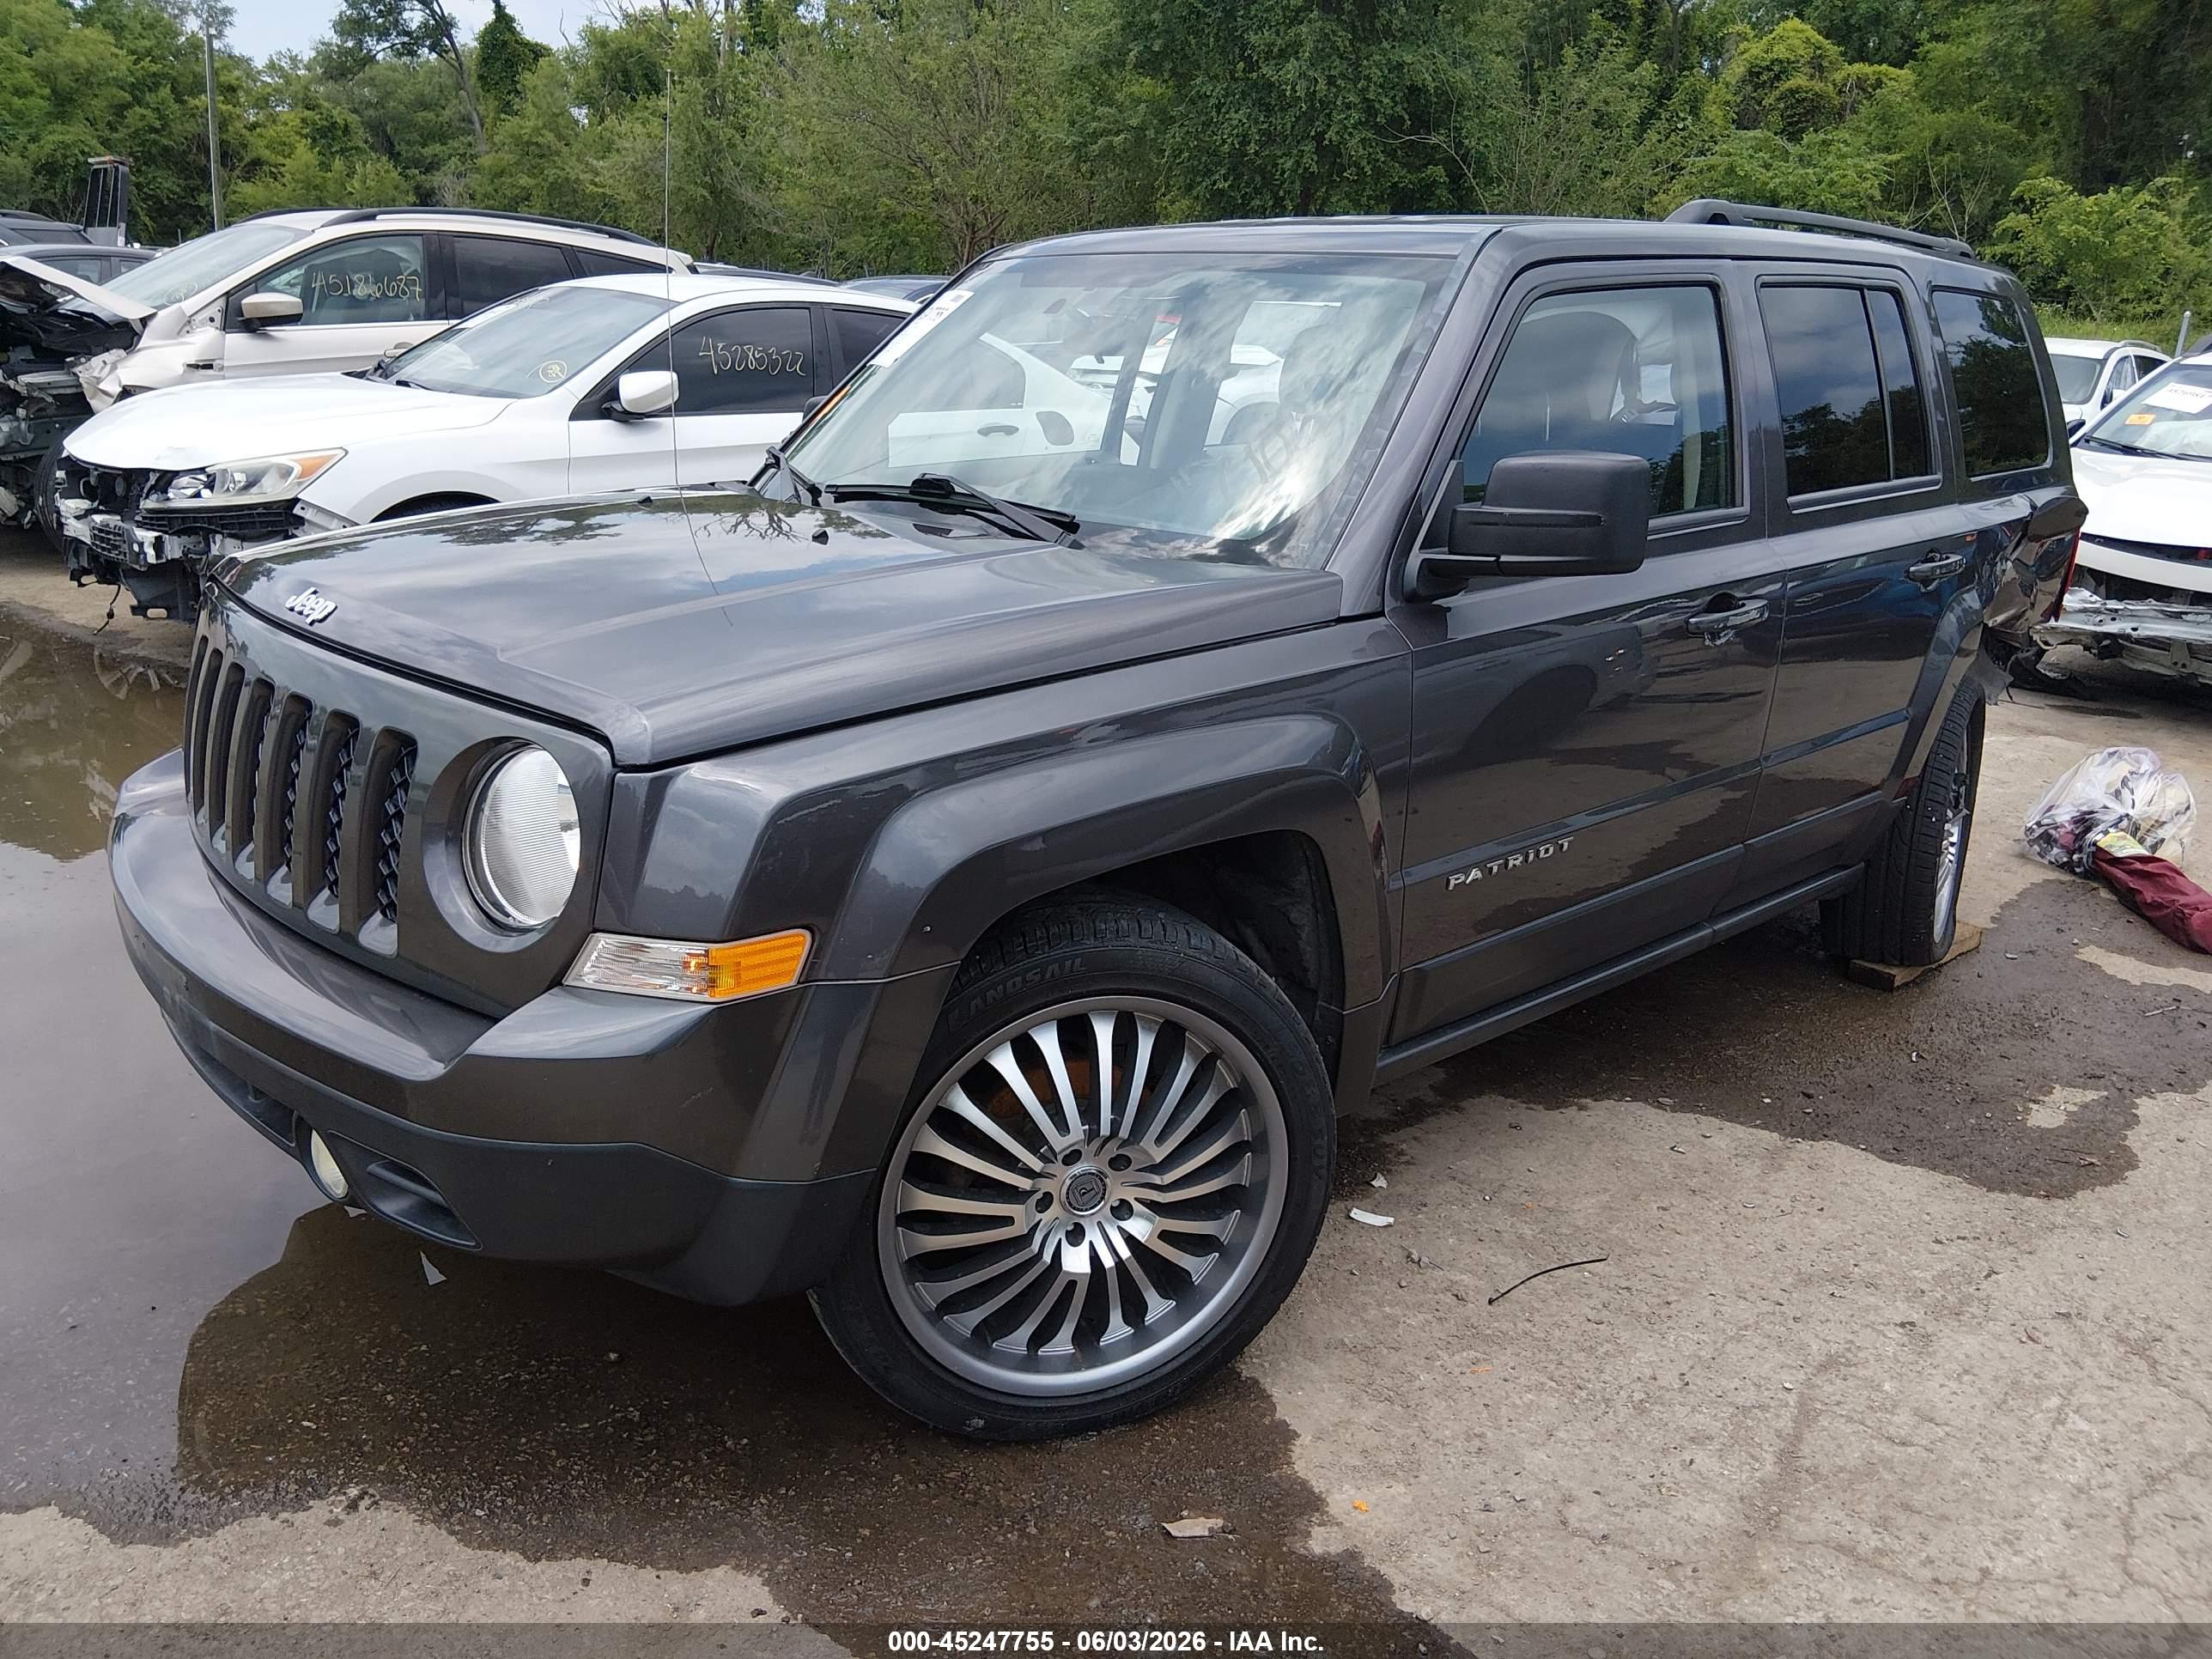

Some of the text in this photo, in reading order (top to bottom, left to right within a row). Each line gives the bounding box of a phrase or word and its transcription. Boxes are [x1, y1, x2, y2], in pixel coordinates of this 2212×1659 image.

[698, 336, 807, 376] 45285322
[284, 586, 338, 624] Jeep
[1446, 836, 1574, 891] PATRIOT
